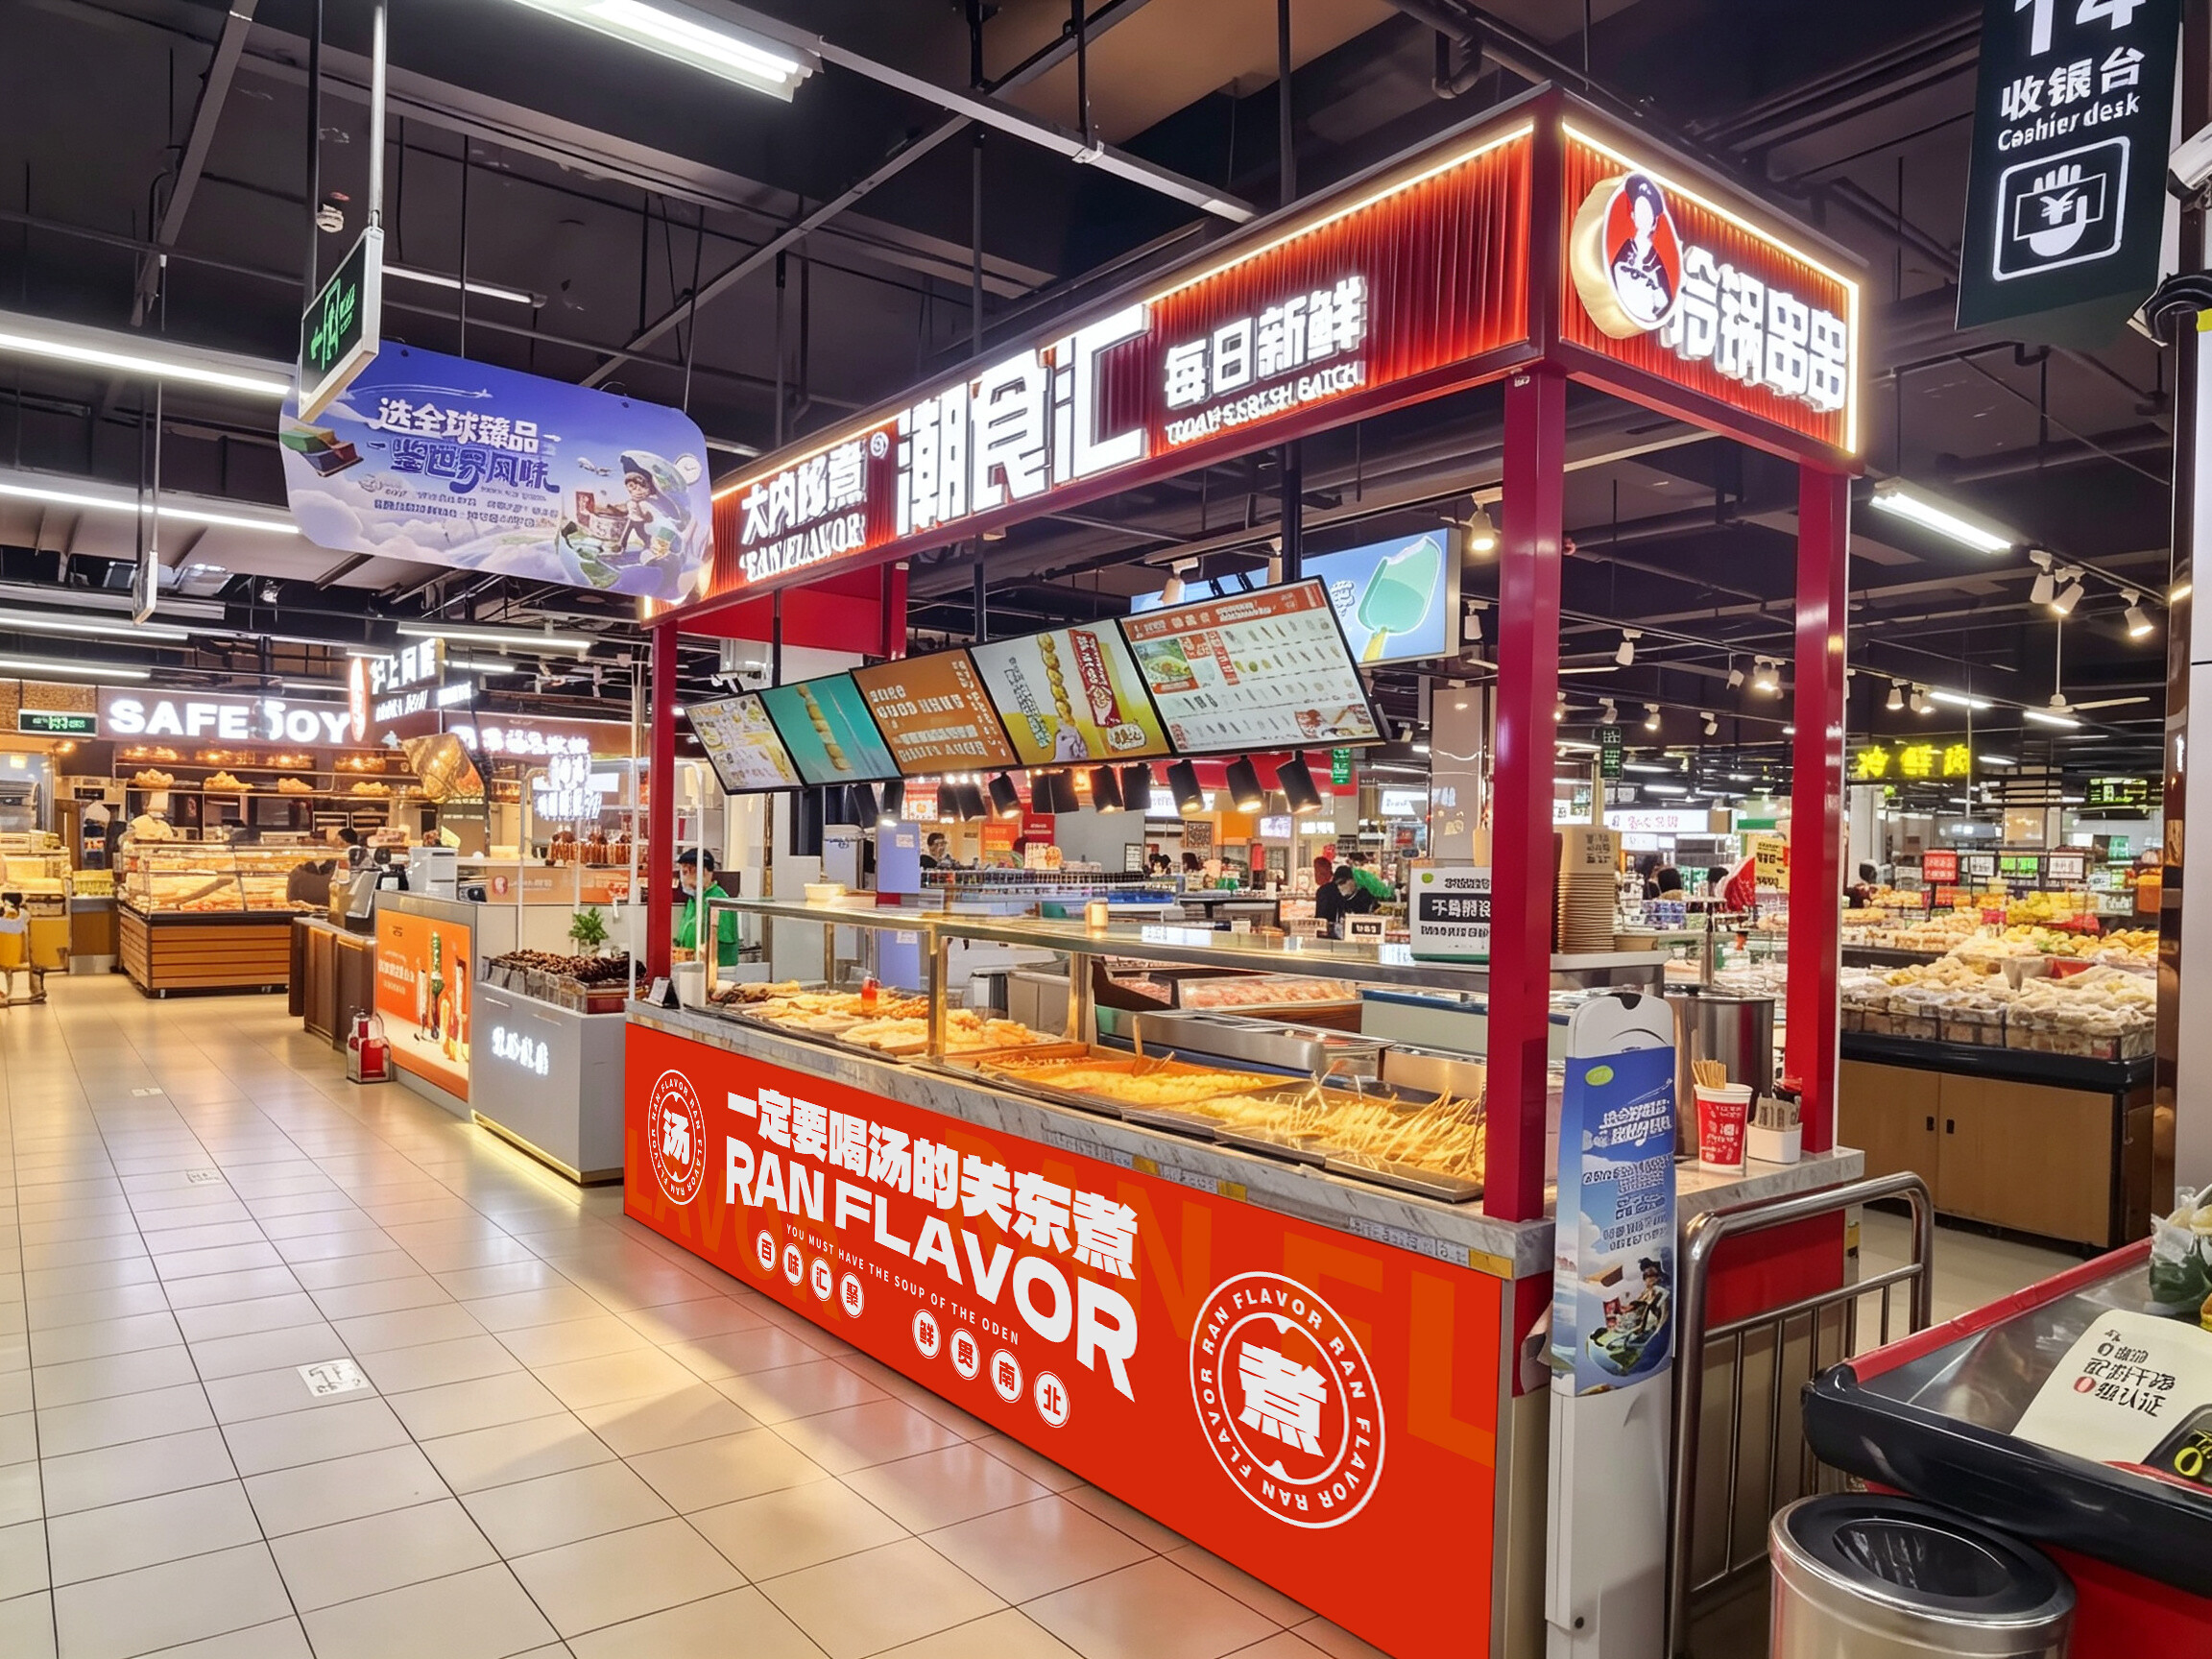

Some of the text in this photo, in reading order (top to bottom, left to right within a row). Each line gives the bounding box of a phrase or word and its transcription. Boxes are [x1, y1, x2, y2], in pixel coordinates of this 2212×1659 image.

[1998, 92, 2140, 151] Cashier desk
[2001, 46, 2145, 121] 收银台
[1165, 276, 1367, 409] 每日新鲜
[378, 398, 539, 453] 选全球臻品
[897, 303, 1150, 536] 潮食汇
[108, 699, 249, 739] SAFE
[260, 701, 351, 743] JOY
[662, 1108, 689, 1165] 汤
[727, 1088, 1138, 1279] 一定要喝汤的关东煮
[726, 1136, 1138, 1403] RAN FLAVOR
[786, 1223, 1018, 1345] YOU MUST HAVE THE SOUP OF THE ODEN
[1201, 1288, 1371, 1511] RAN FLAVOR RAN FLAVOR RAN FLAVOR
[1238, 1341, 1327, 1457] 煮
